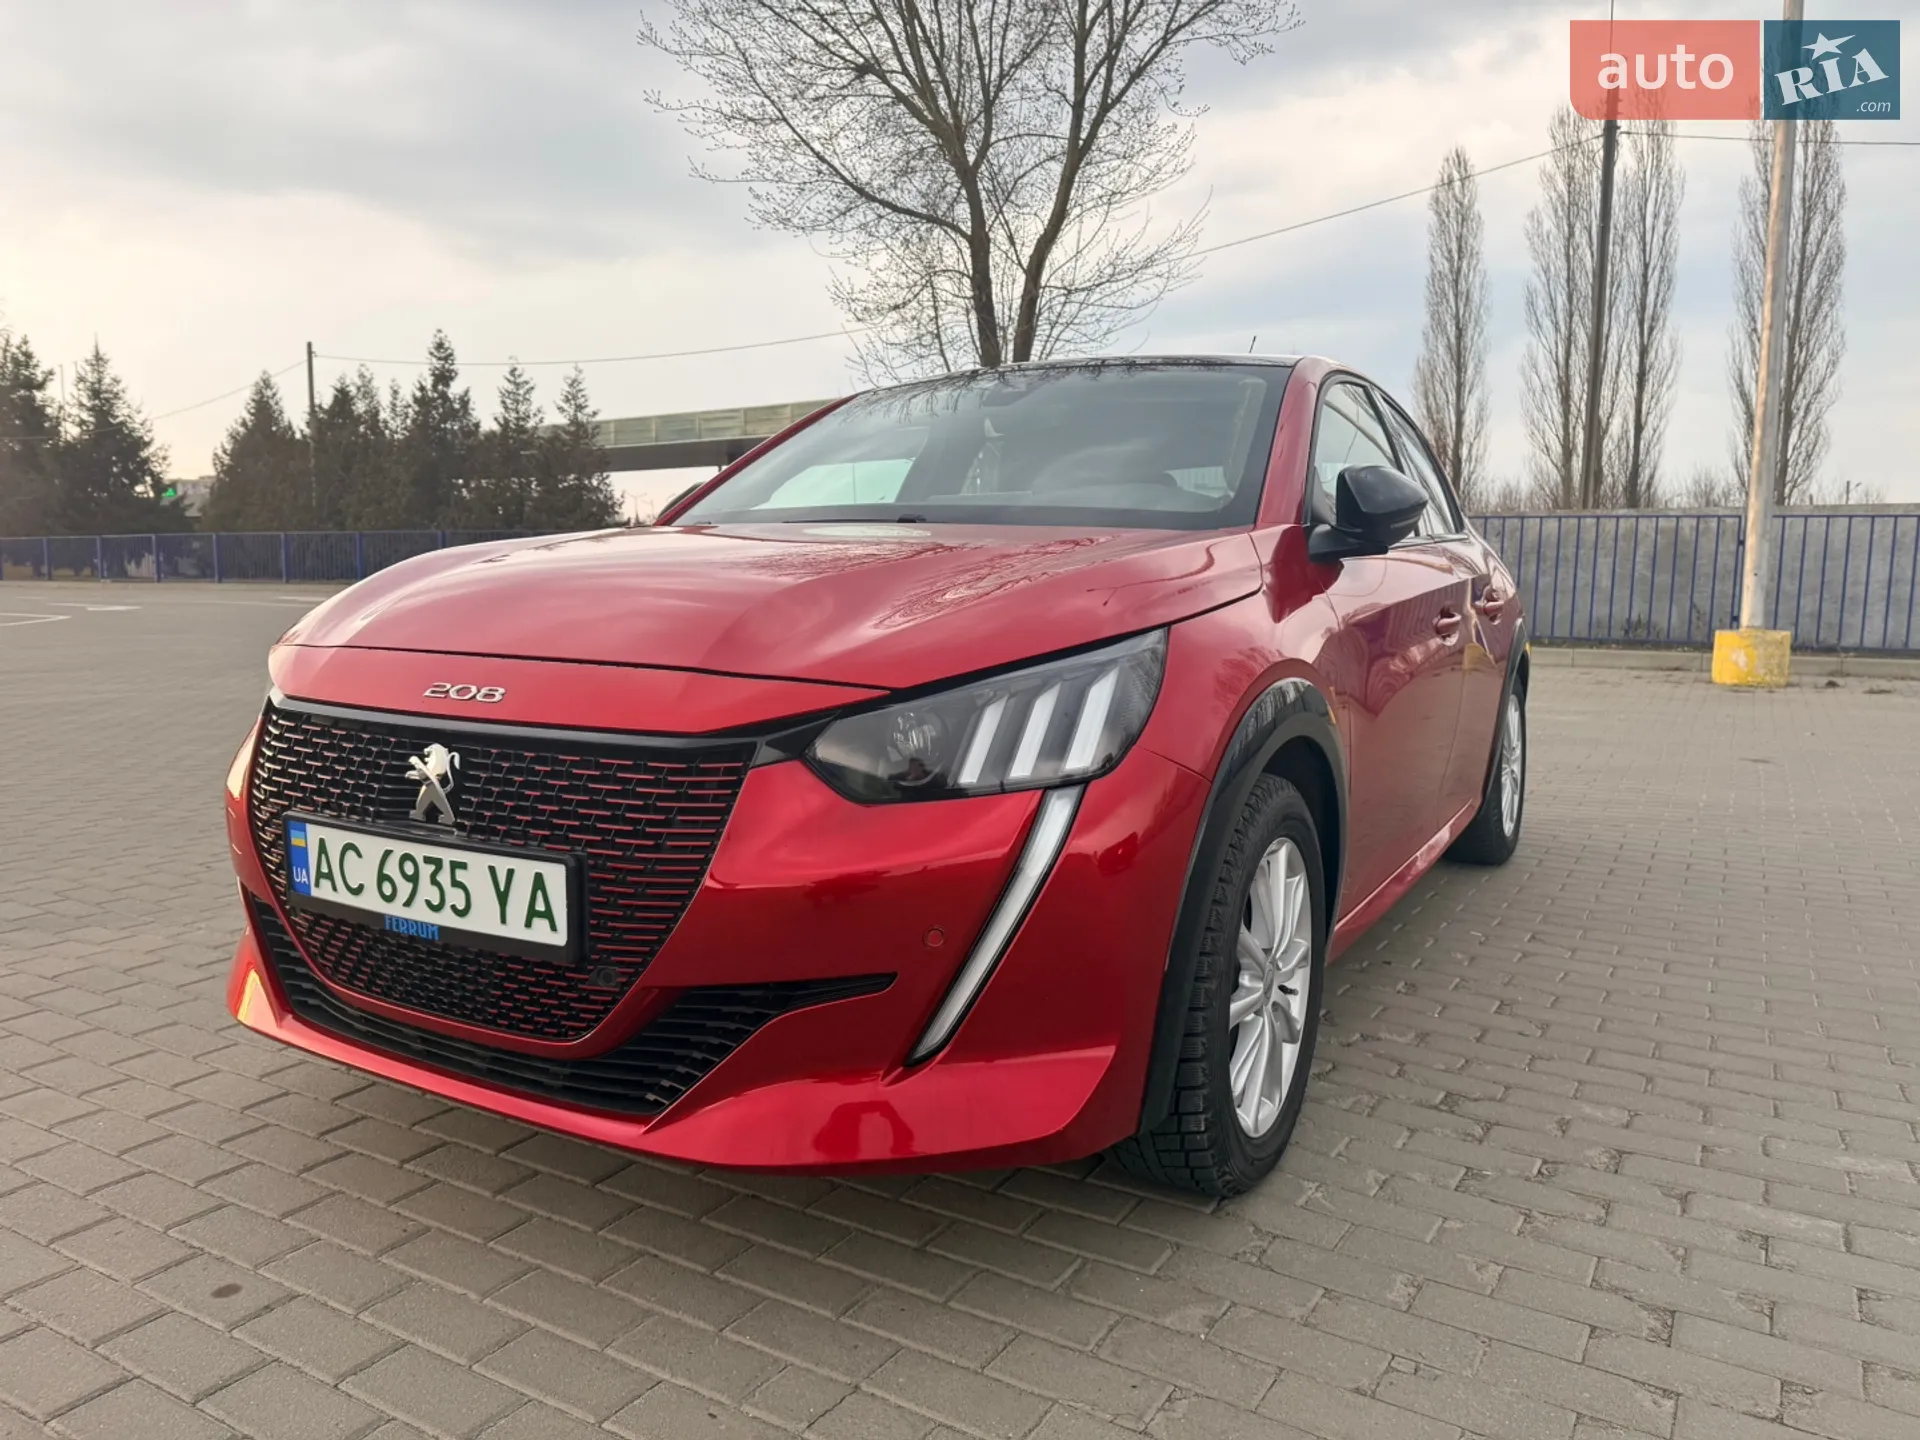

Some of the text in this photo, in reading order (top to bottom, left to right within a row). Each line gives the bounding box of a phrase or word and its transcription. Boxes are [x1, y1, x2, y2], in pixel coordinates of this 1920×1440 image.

[423, 682, 506, 703] 208
[293, 866, 309, 884] UA
[314, 837, 558, 932] AC 6935 YA
[384, 914, 440, 941] FERRUM
